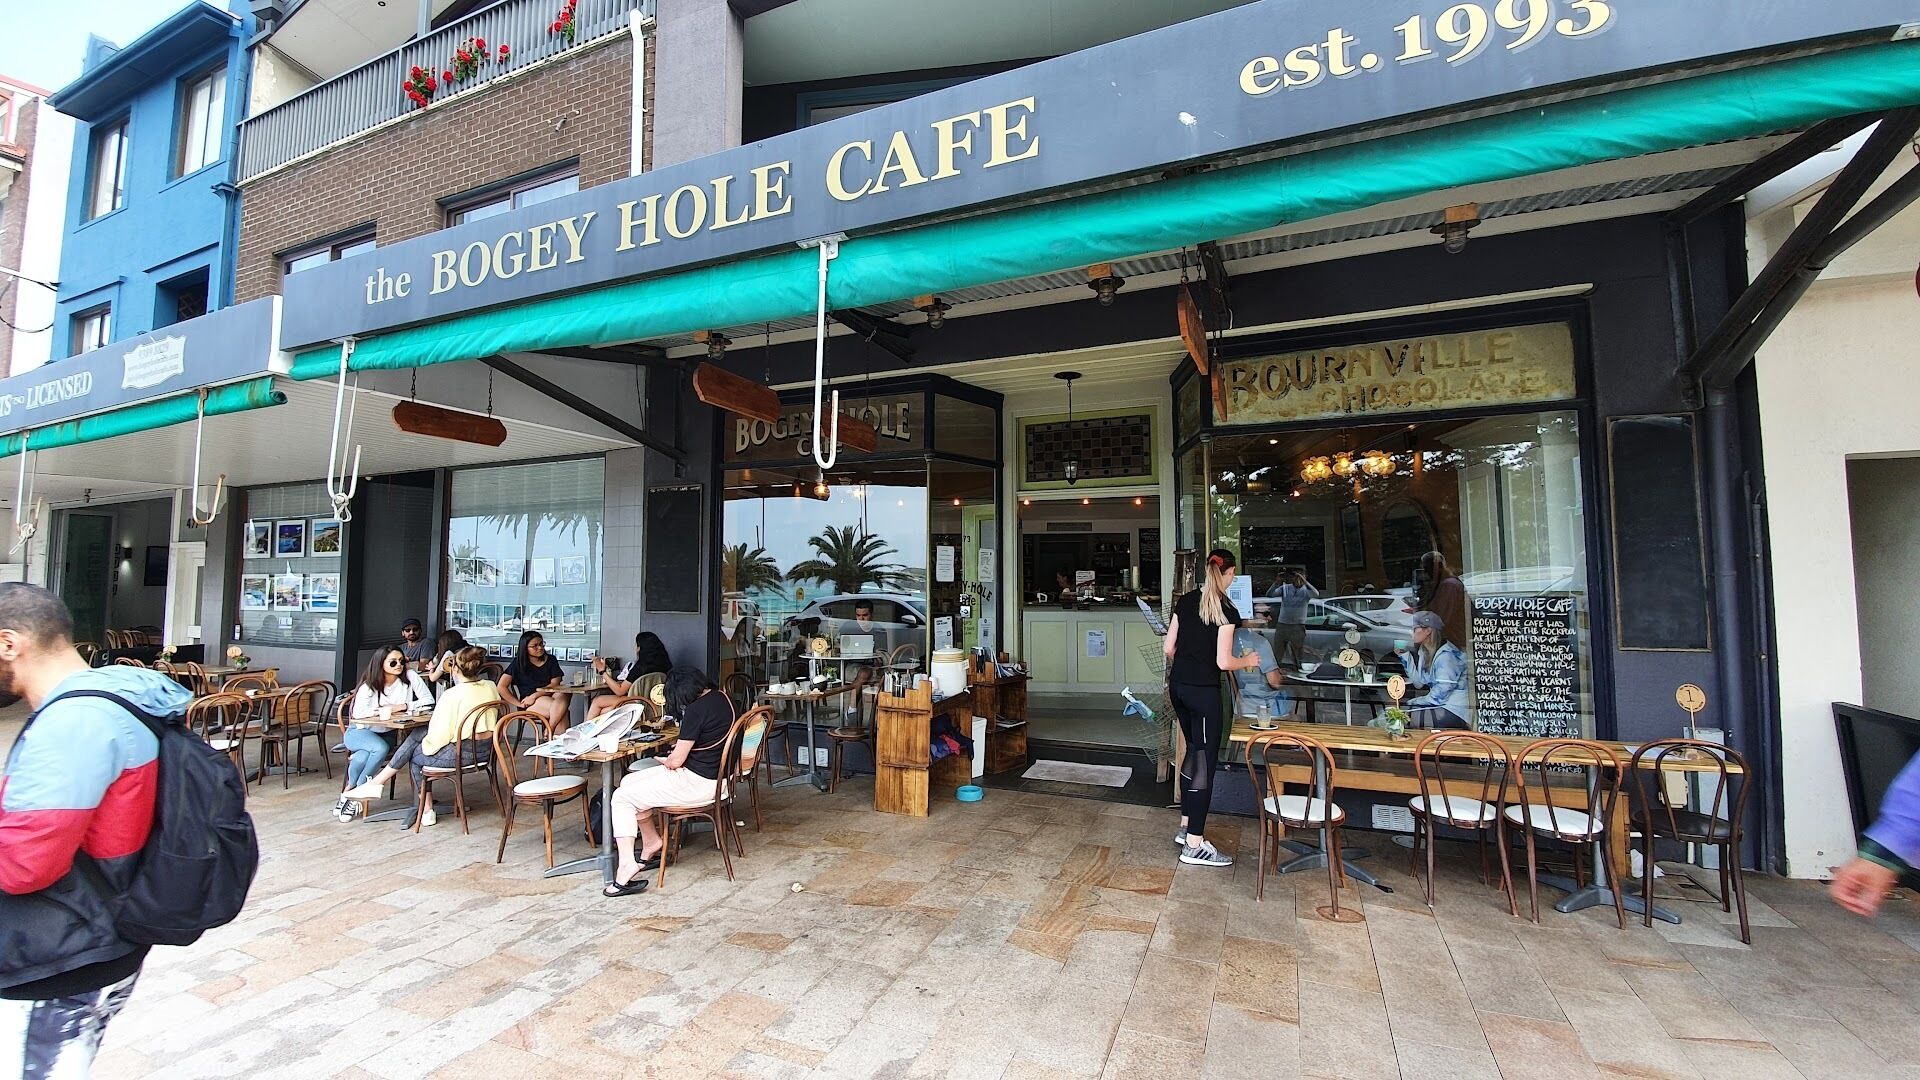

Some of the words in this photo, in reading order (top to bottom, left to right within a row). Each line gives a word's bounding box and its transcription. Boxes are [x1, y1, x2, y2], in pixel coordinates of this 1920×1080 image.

[365, 267, 412, 305] the
[430, 212, 598, 296] BOGEY
[615, 160, 794, 253] HOLE
[825, 96, 1041, 202] CAFE
[1238, 27, 1381, 97] est.
[1393, 0, 1614, 63] 1993
[1226, 332, 1514, 412] BOURNVILLE
[26, 371, 93, 410] LICENSED
[1475, 597, 1513, 610] BOGEY
[1514, 598, 1546, 610] HOLE
[1546, 598, 1573, 612] CAFE
[1526, 610, 1546, 618] 1993
[1473, 618, 1498, 626] BOGEY
[1500, 619, 1521, 627] HOLE
[1523, 620, 1545, 628] CAFE
[1547, 620, 1565, 628] WAS
[1473, 626, 1497, 634] NAMED
[1530, 635, 1546, 643] END
[1474, 642, 1504, 650] BRONTE
[1342, 653, 1354, 662] 22
[1486, 651, 1498, 659] AN
[1500, 651, 1549, 661] ABORIGINAL
[1551, 653, 1574, 661] WORD
[1490, 659, 1509, 667] SAFE
[1511, 660, 1553, 668] SWIMMING
[1554, 660, 1576, 670] HOLE
[1494, 667, 1548, 677] GENERATIONS
[1393, 679, 1400, 692] 2
[1475, 674, 1514, 683] TODDLERS
[1515, 676, 1538, 685] HAVE
[1540, 677, 1573, 686] LEARNT
[1488, 684, 1510, 692] SWIM
[1540, 686, 1551, 694] TO
[1553, 687, 1572, 695] THE
[1477, 692, 1506, 700] LOCALS
[1527, 693, 1535, 701] A
[1535, 694, 1570, 703] SPECIAL
[1685, 689, 1695, 702] 1
[1514, 701, 1541, 710] FRESH
[1543, 702, 1577, 711] HONEST
[1477, 709, 1497, 717] FOOD
[1509, 710, 1528, 718] OUR
[1529, 711, 1577, 720] PHILOSOPHY
